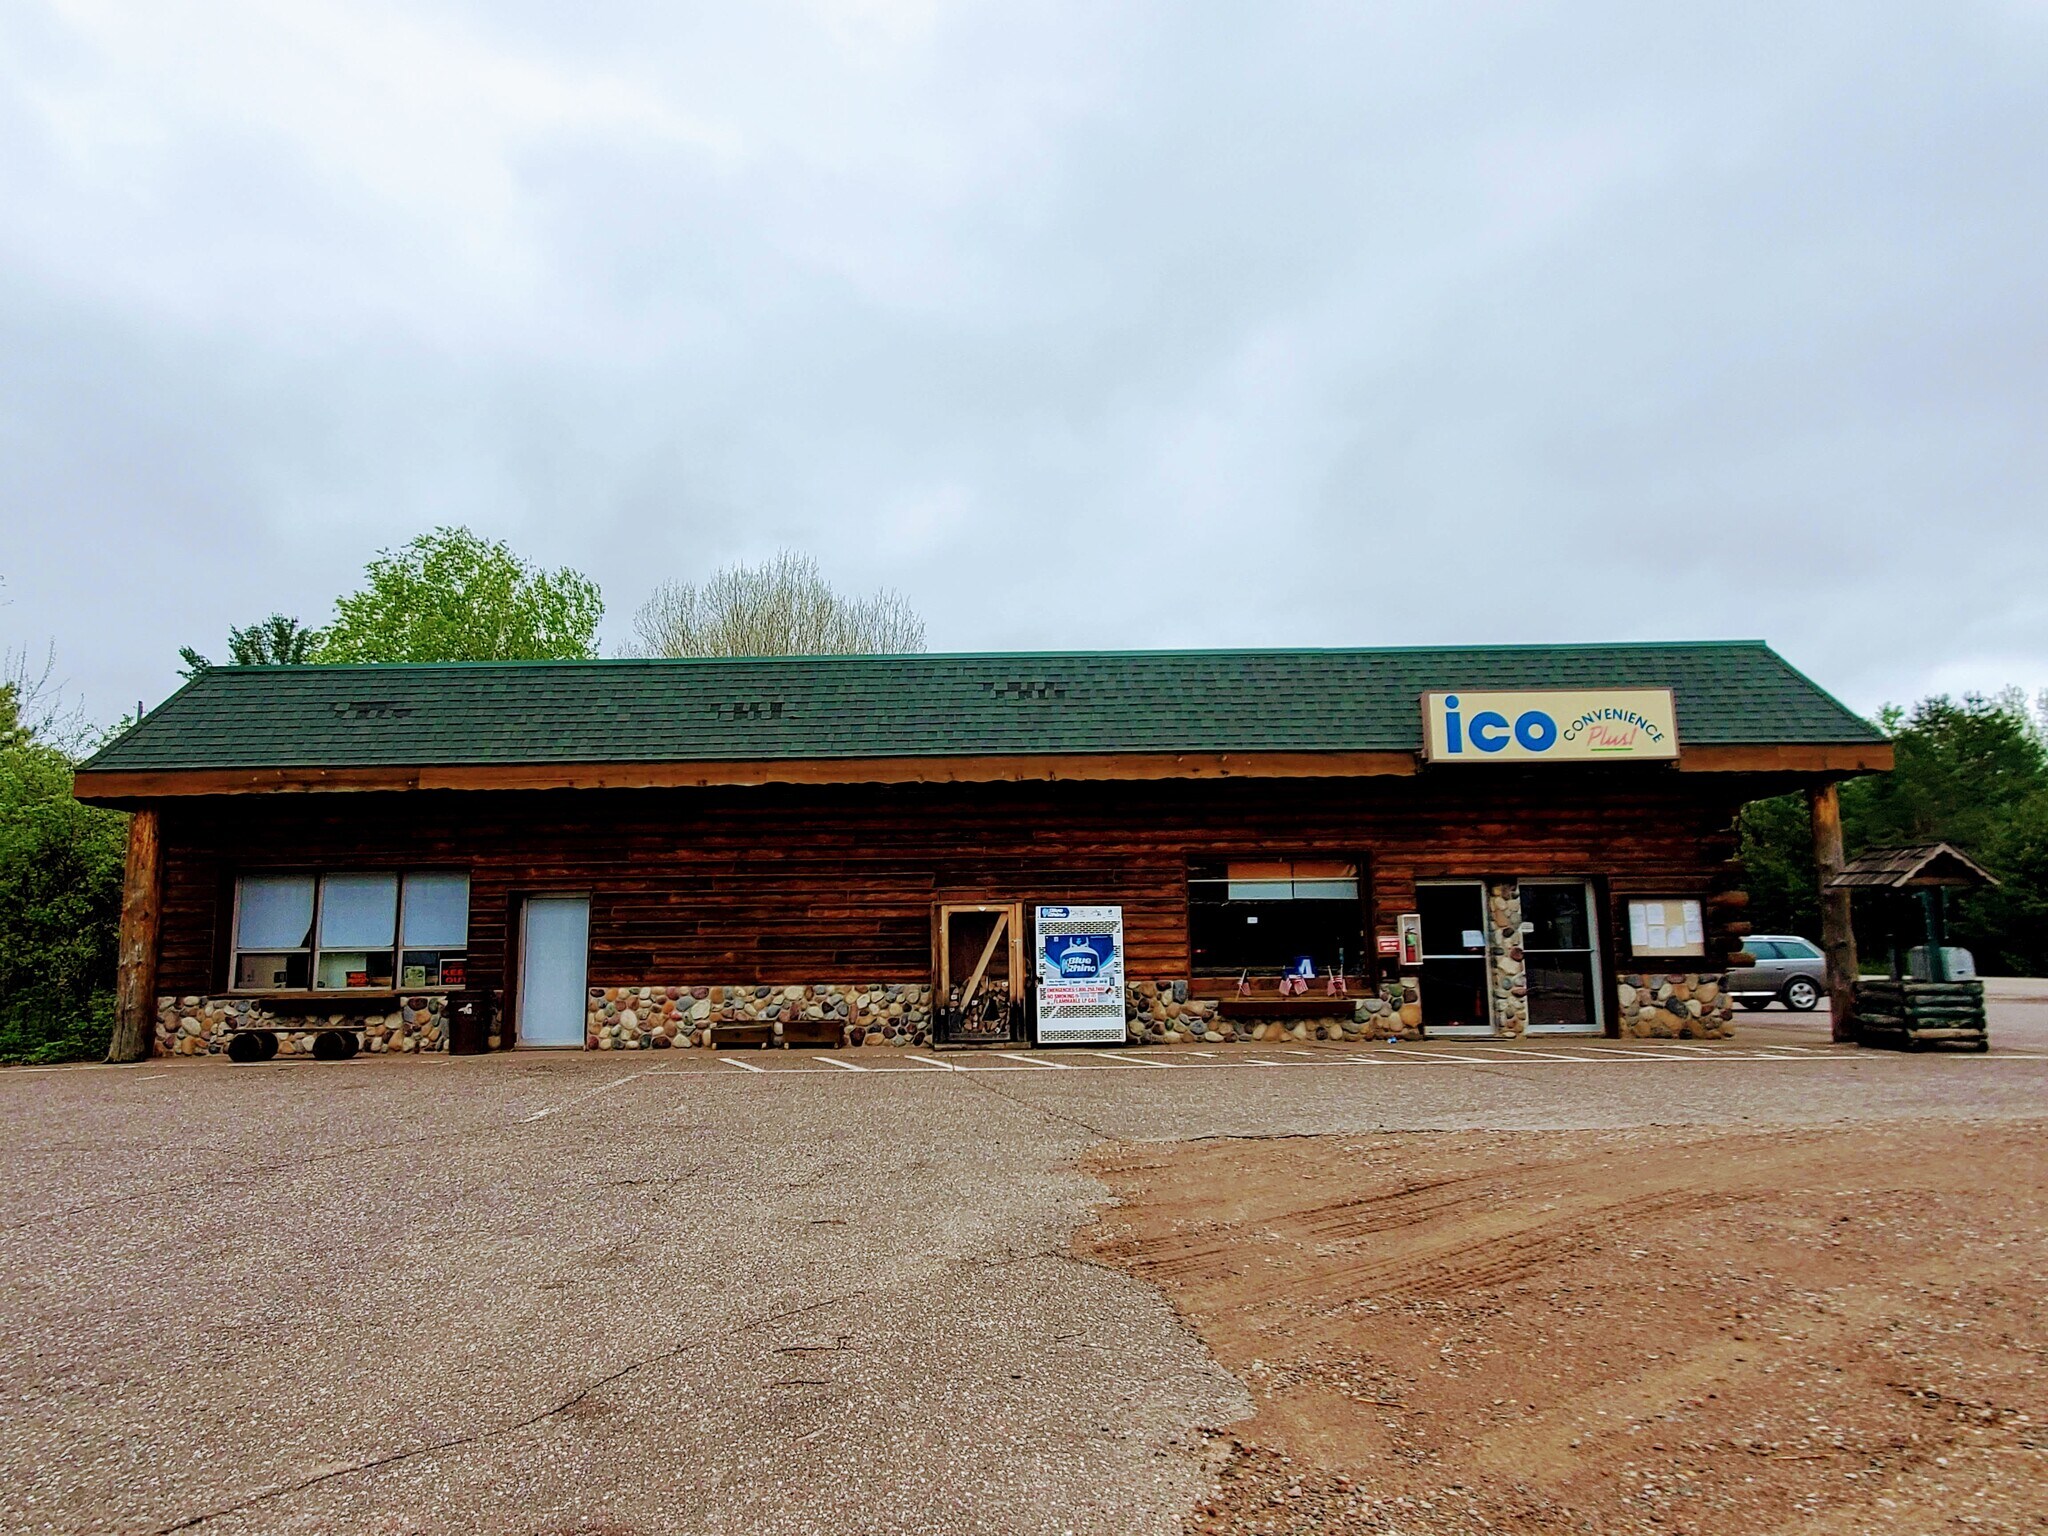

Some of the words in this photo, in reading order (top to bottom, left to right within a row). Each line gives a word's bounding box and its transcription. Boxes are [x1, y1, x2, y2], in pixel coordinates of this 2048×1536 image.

[1445, 695, 1557, 753] ico
[1563, 708, 1665, 743] CONVENIENCE
[1587, 726, 1637, 747] Plus!
